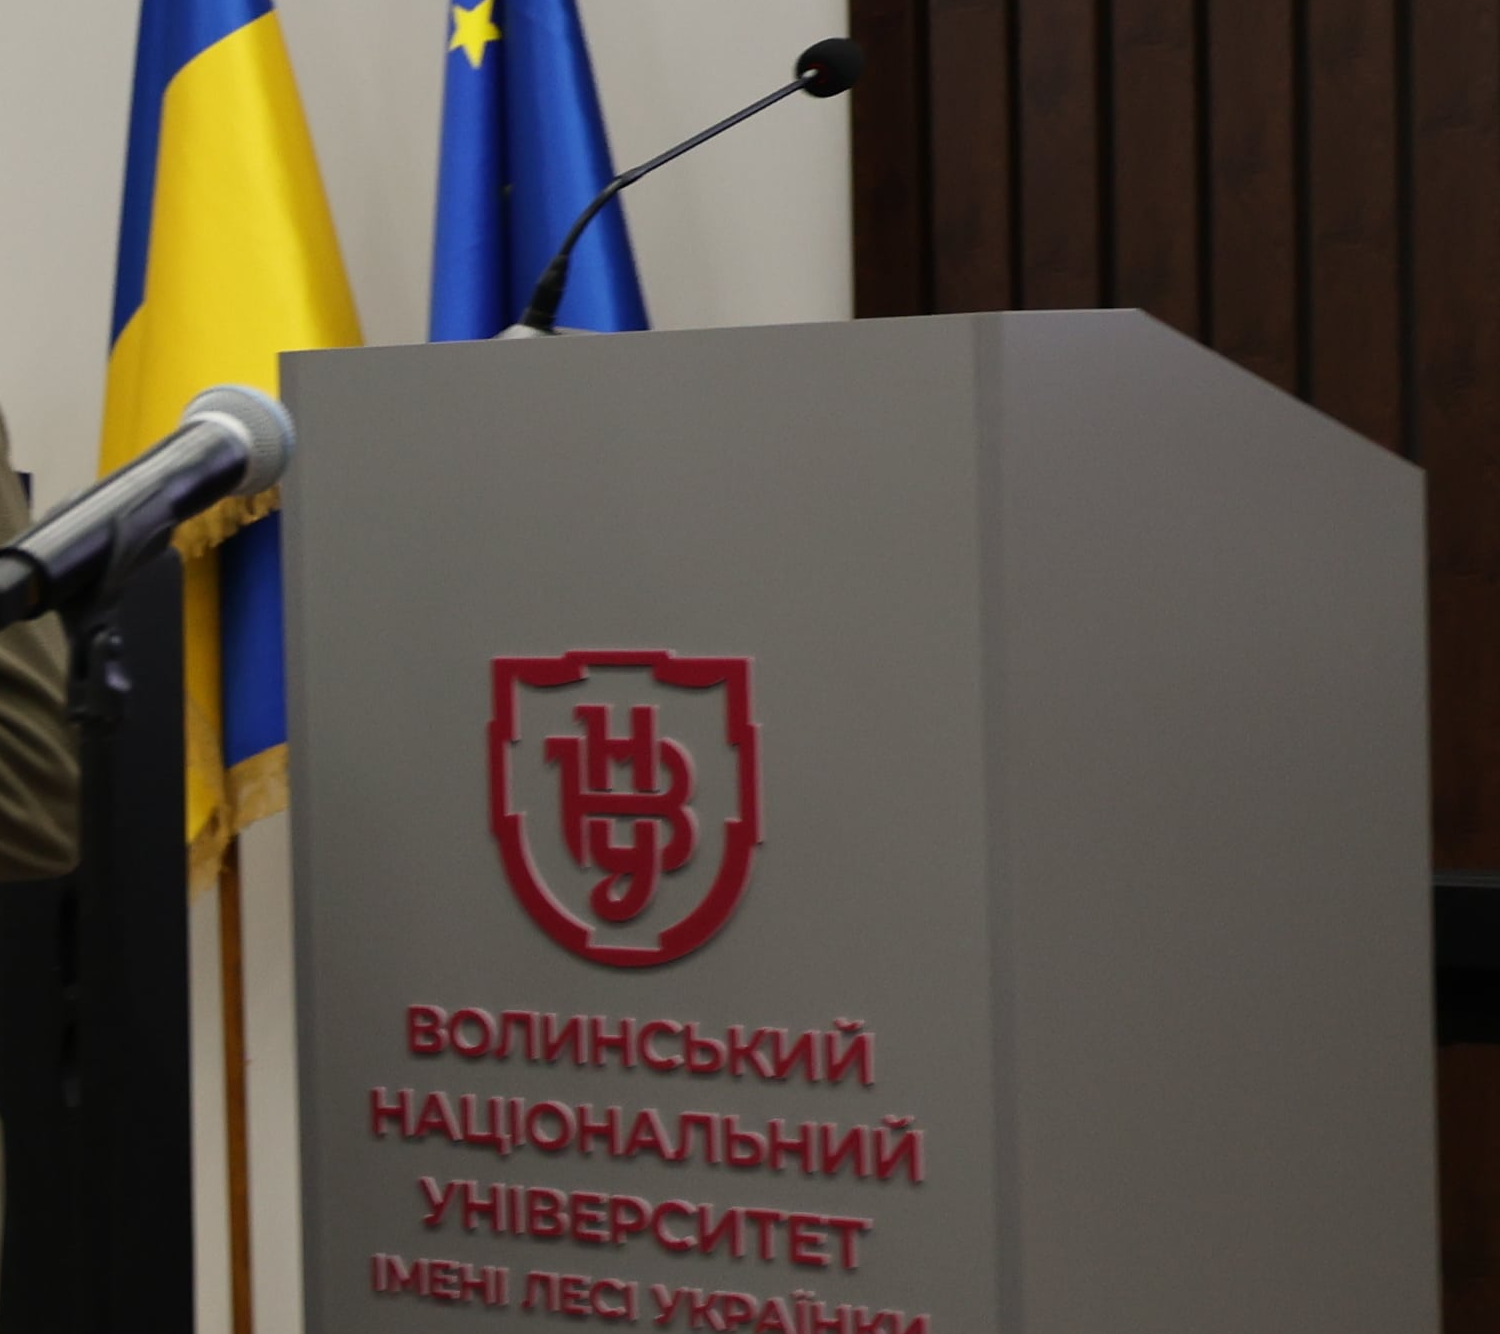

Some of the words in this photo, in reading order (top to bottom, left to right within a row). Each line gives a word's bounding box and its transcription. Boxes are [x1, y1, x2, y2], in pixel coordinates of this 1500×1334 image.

[407, 1004, 875, 1087] ВОЛИНСЬКИЙ
[369, 1087, 926, 1184] НАЦІОНАЛЬНИЙ
[419, 1174, 872, 1270] УНІВЕРСИТЕТ
[372, 1253, 508, 1308] ІМЕНІ
[521, 1271, 640, 1322] ЛЕСІ
